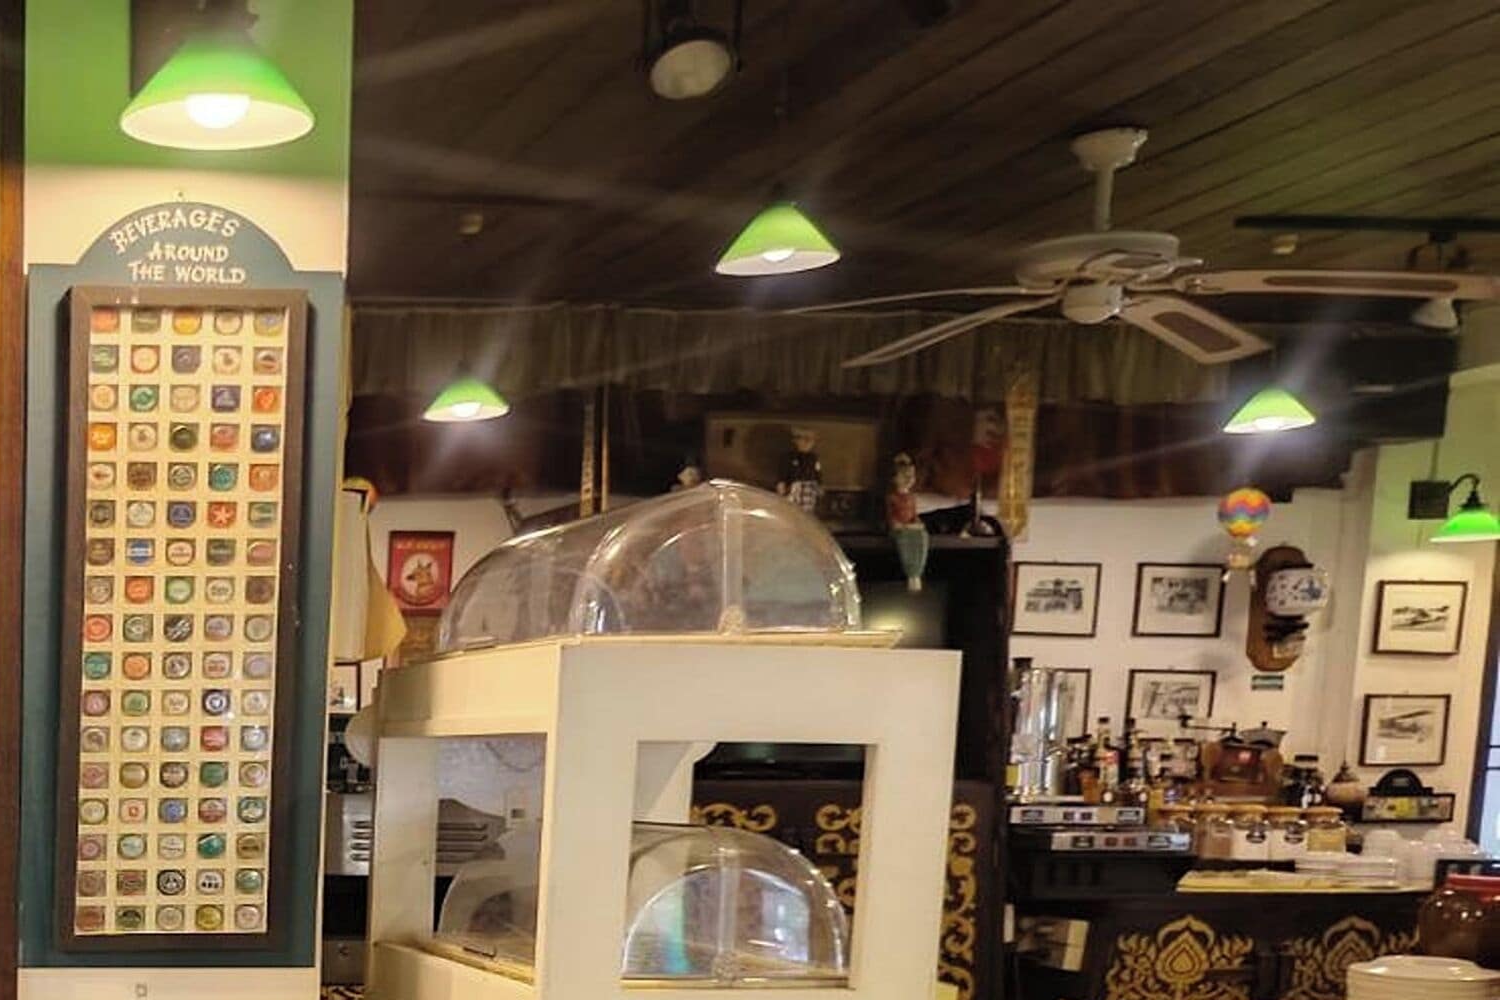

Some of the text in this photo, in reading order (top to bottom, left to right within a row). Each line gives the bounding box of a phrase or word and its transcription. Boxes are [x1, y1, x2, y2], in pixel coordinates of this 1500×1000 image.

[108, 208, 240, 254] BEVERAGES
[148, 241, 229, 262] AROUND
[128, 260, 246, 284] THE WORLD
